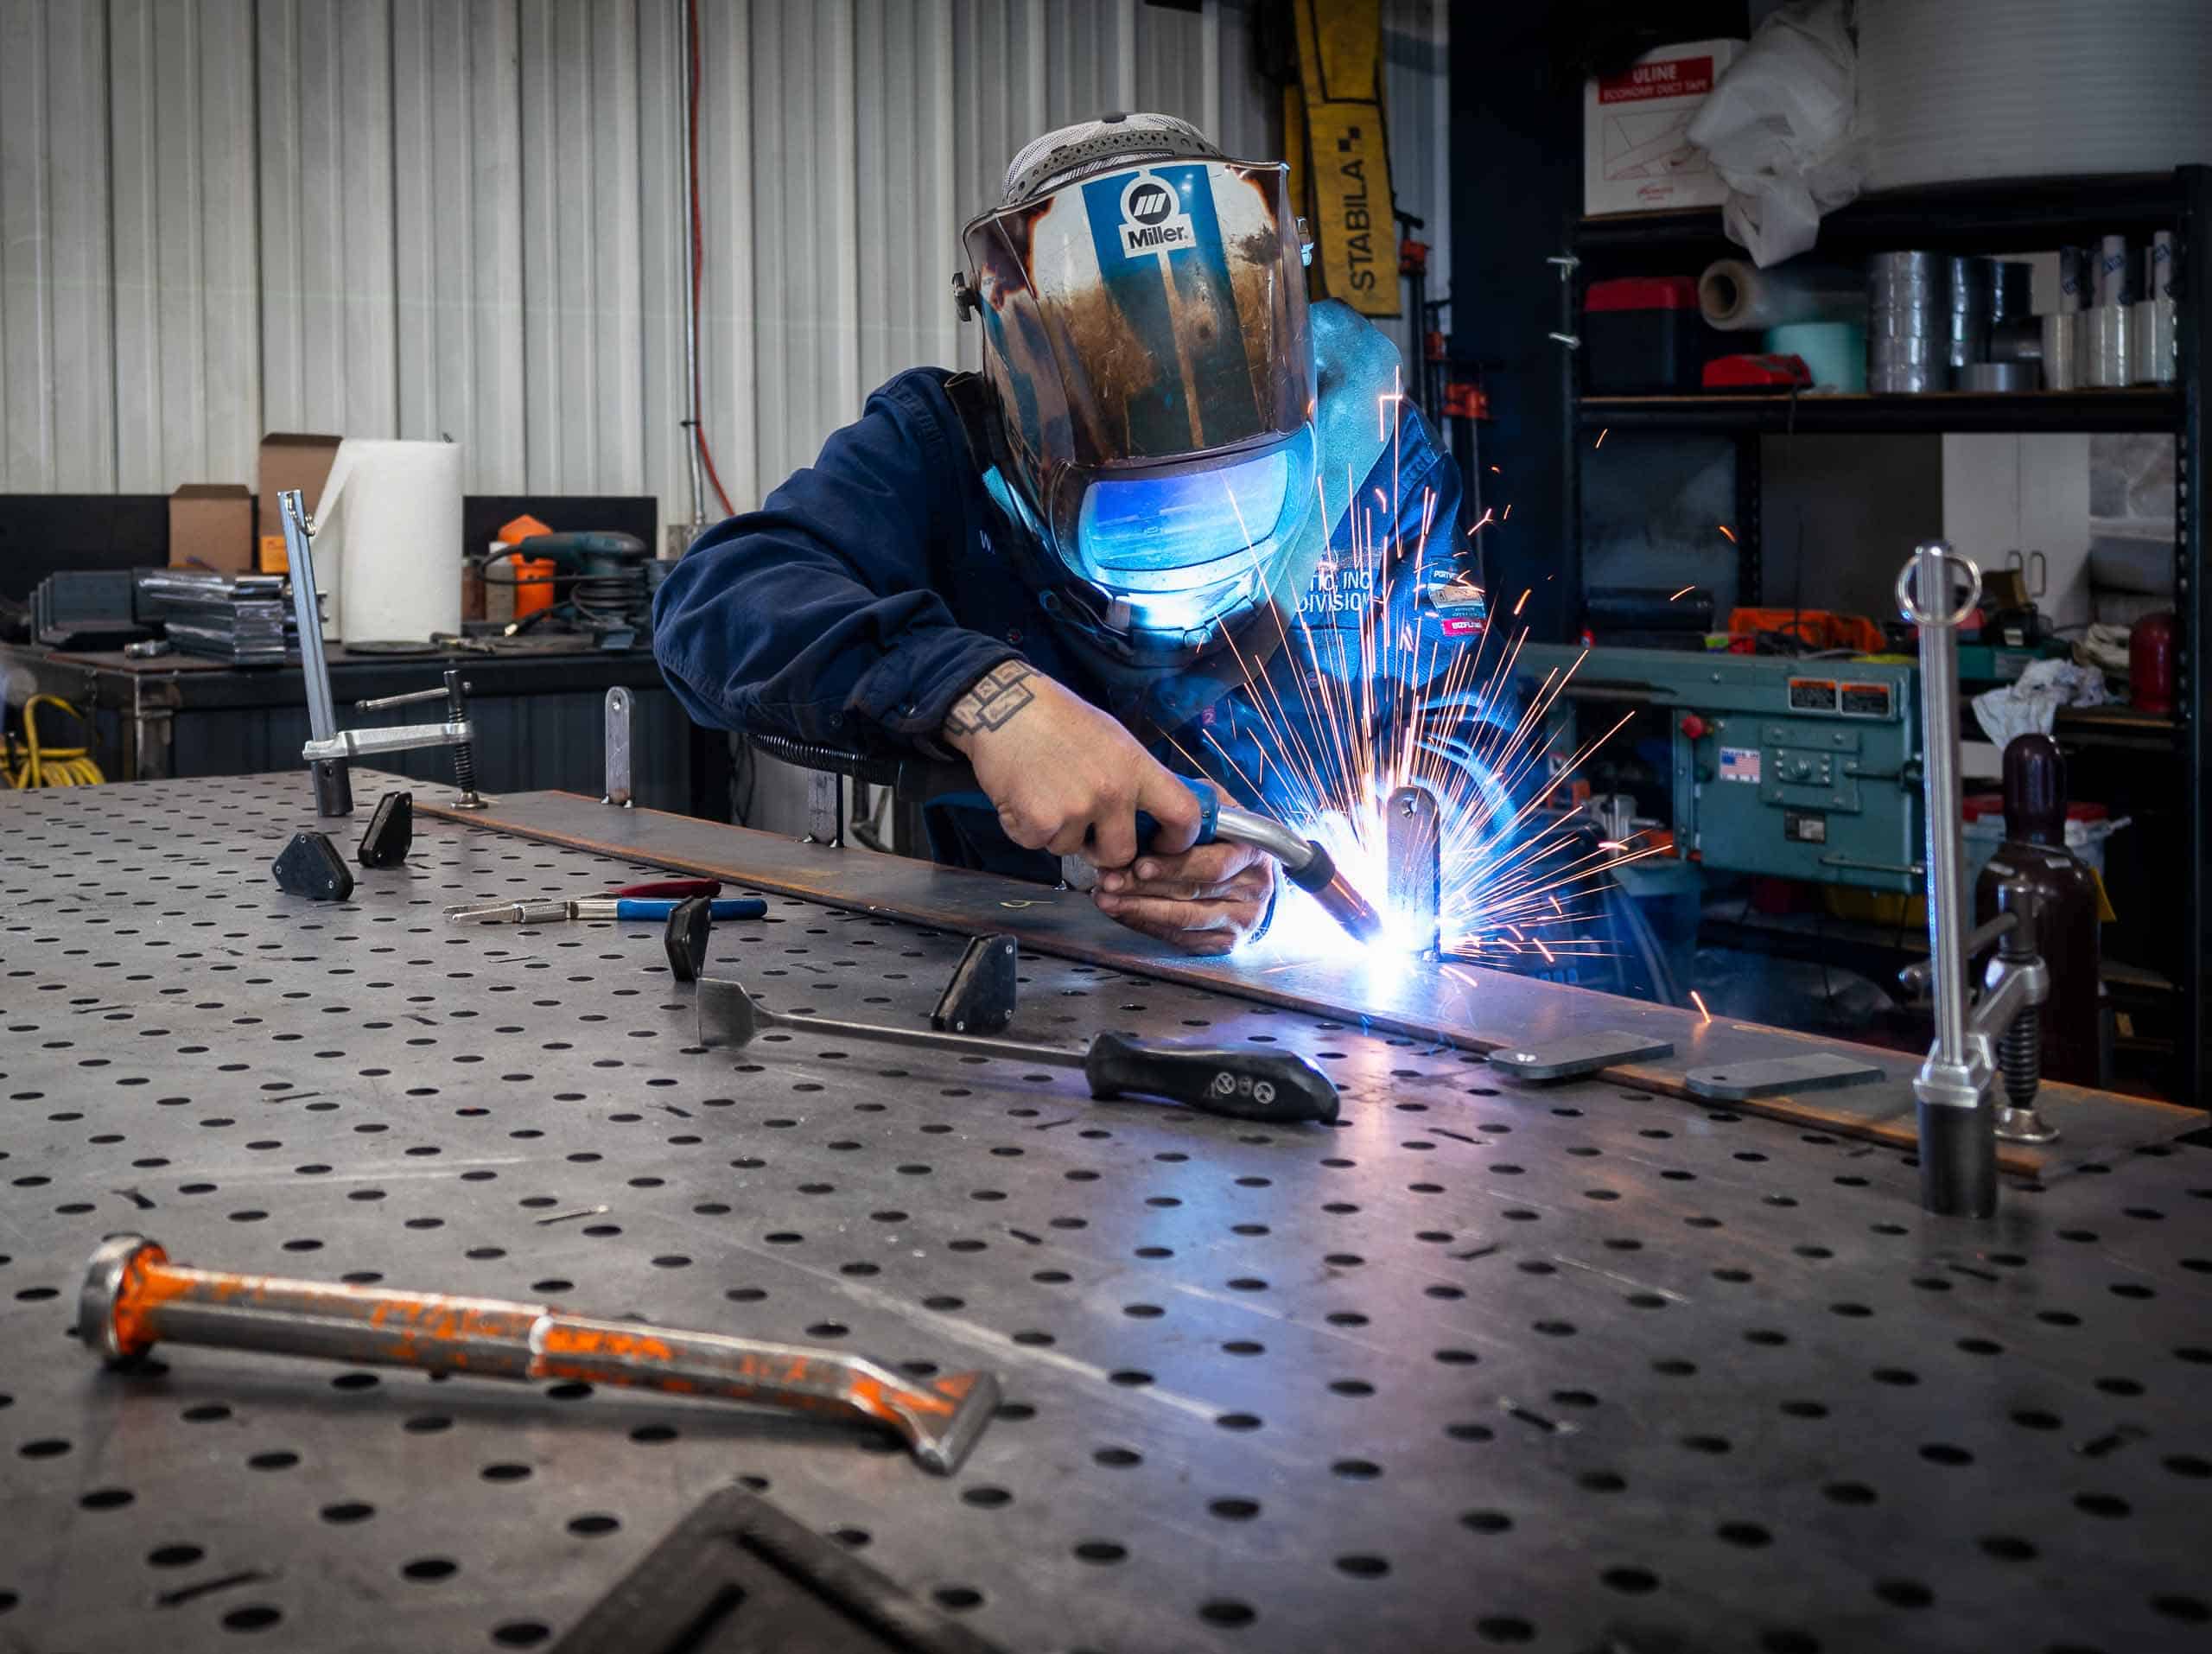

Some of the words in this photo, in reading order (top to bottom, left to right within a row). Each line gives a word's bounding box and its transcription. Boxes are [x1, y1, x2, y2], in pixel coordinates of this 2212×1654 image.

[1633, 64, 1676, 83] ULINE
[1604, 86, 1654, 100] ECONOMY
[1657, 83, 1681, 95] DUCT
[1686, 80, 1707, 91] TAPE
[1341, 159, 1375, 290] STABILA
[1128, 226, 1185, 249] Miller
